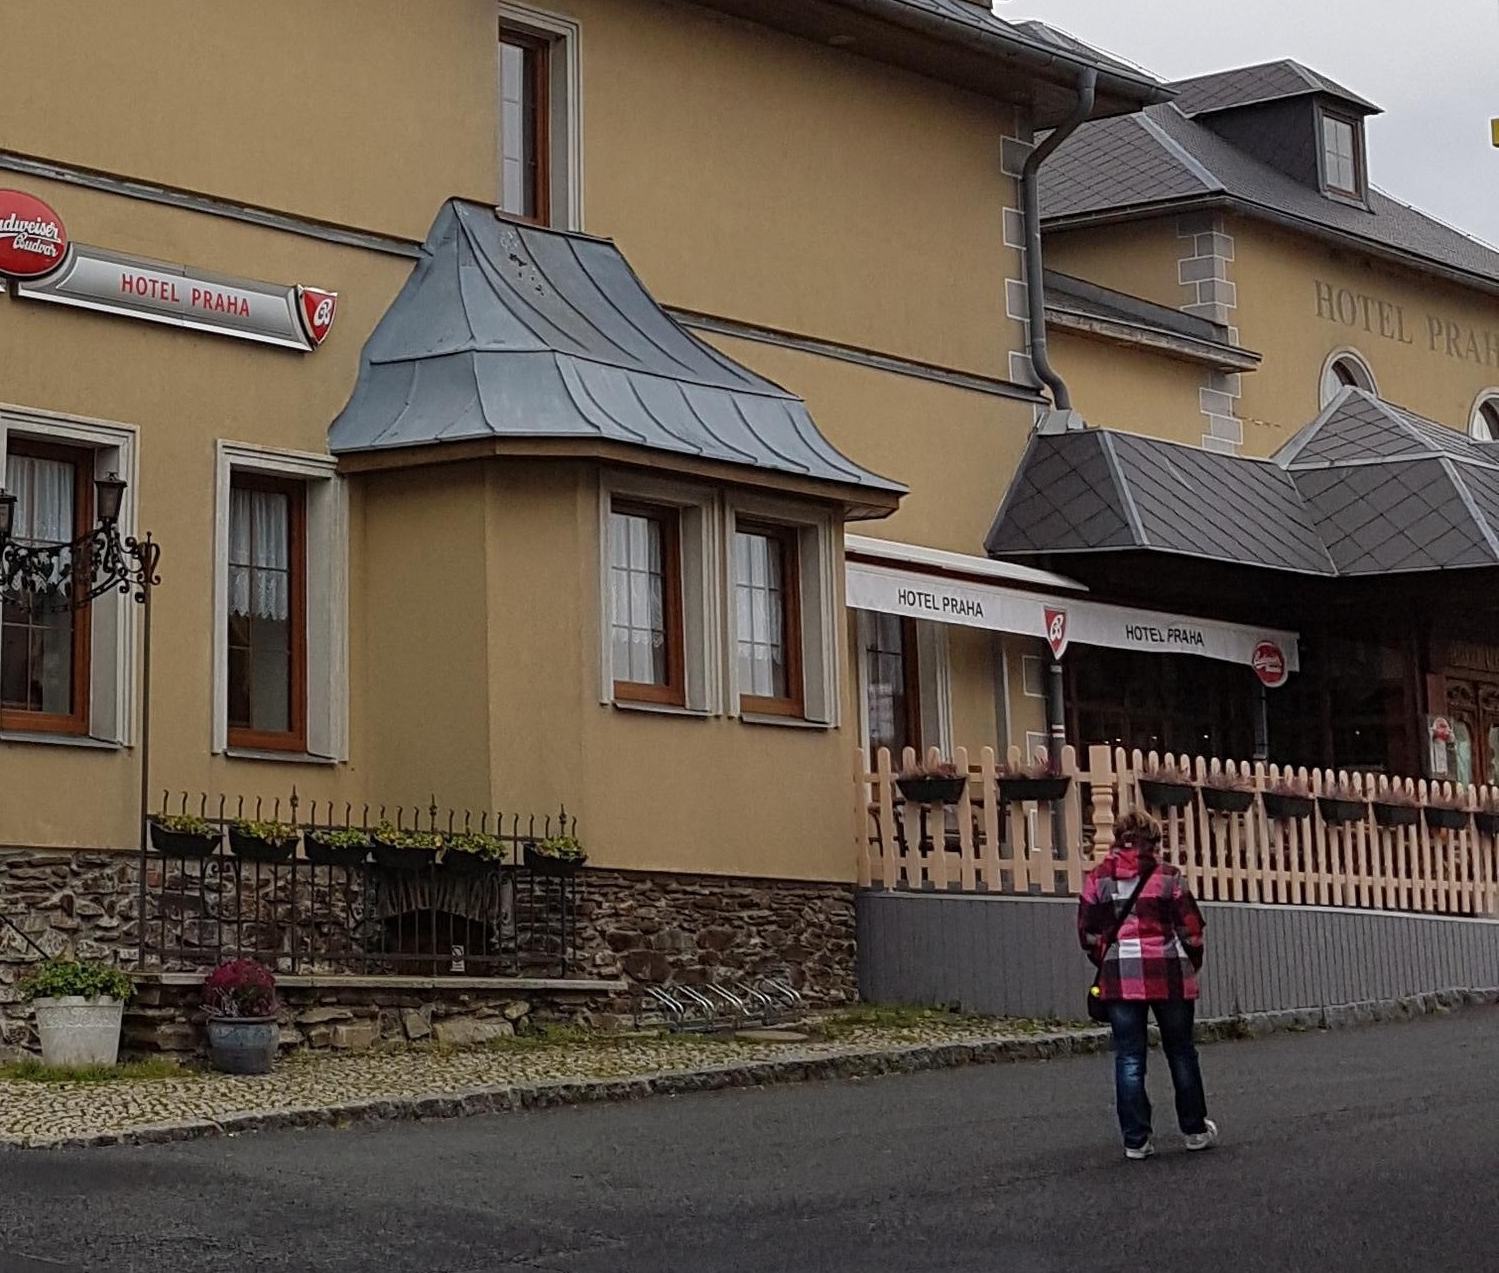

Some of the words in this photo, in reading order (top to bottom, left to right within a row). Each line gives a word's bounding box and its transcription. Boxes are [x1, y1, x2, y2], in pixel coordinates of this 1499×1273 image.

[12, 232, 58, 257] Budvar
[121, 273, 180, 303] HOTEL
[191, 288, 250, 318] PRAHA
[1314, 280, 1413, 345] HOTEL
[898, 589, 940, 610] HOTEL
[942, 596, 984, 618] PRAHA
[1126, 625, 1165, 643] HOTEL
[1167, 628, 1205, 647] PRAHA
